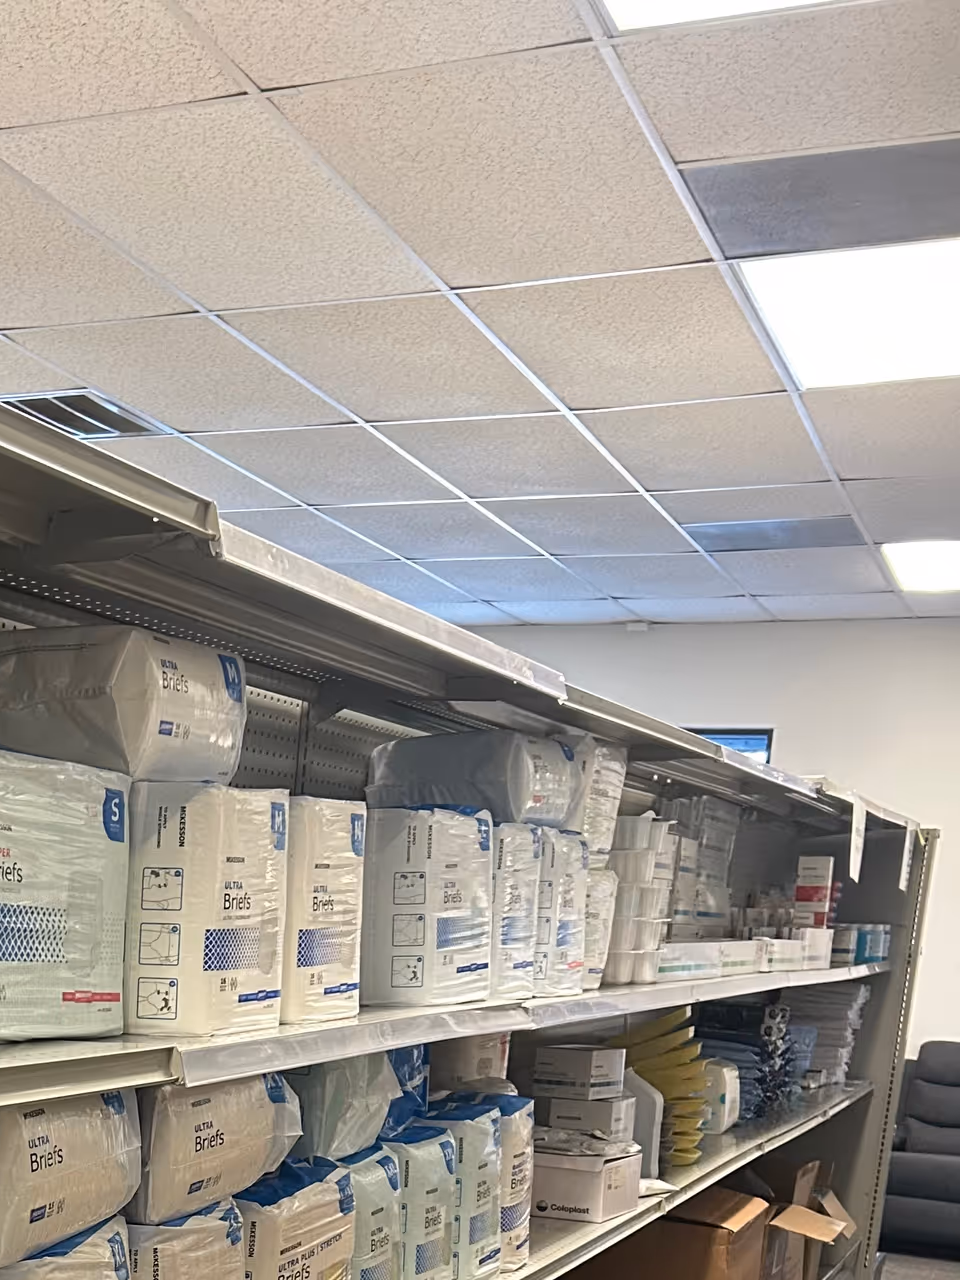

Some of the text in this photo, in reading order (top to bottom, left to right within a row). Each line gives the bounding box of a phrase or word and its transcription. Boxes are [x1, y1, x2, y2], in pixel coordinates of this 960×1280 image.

[162, 670, 189, 694] Briefs
[111, 799, 120, 821] S
[224, 880, 244, 891] ULTRA
[223, 892, 252, 911] Briefs
[312, 895, 334, 911] Briefs
[194, 1120, 214, 1133] ULTRA
[27, 1134, 50, 1150] ULTRA
[194, 1128, 224, 1153] Briefs
[29, 1143, 64, 1173] Briefs
[550, 1202, 590, 1216] Coloplast
[424, 1211, 442, 1229] Briefs
[370, 1232, 390, 1253] Briefs
[277, 1249, 316, 1273] ULTRA PLUS
